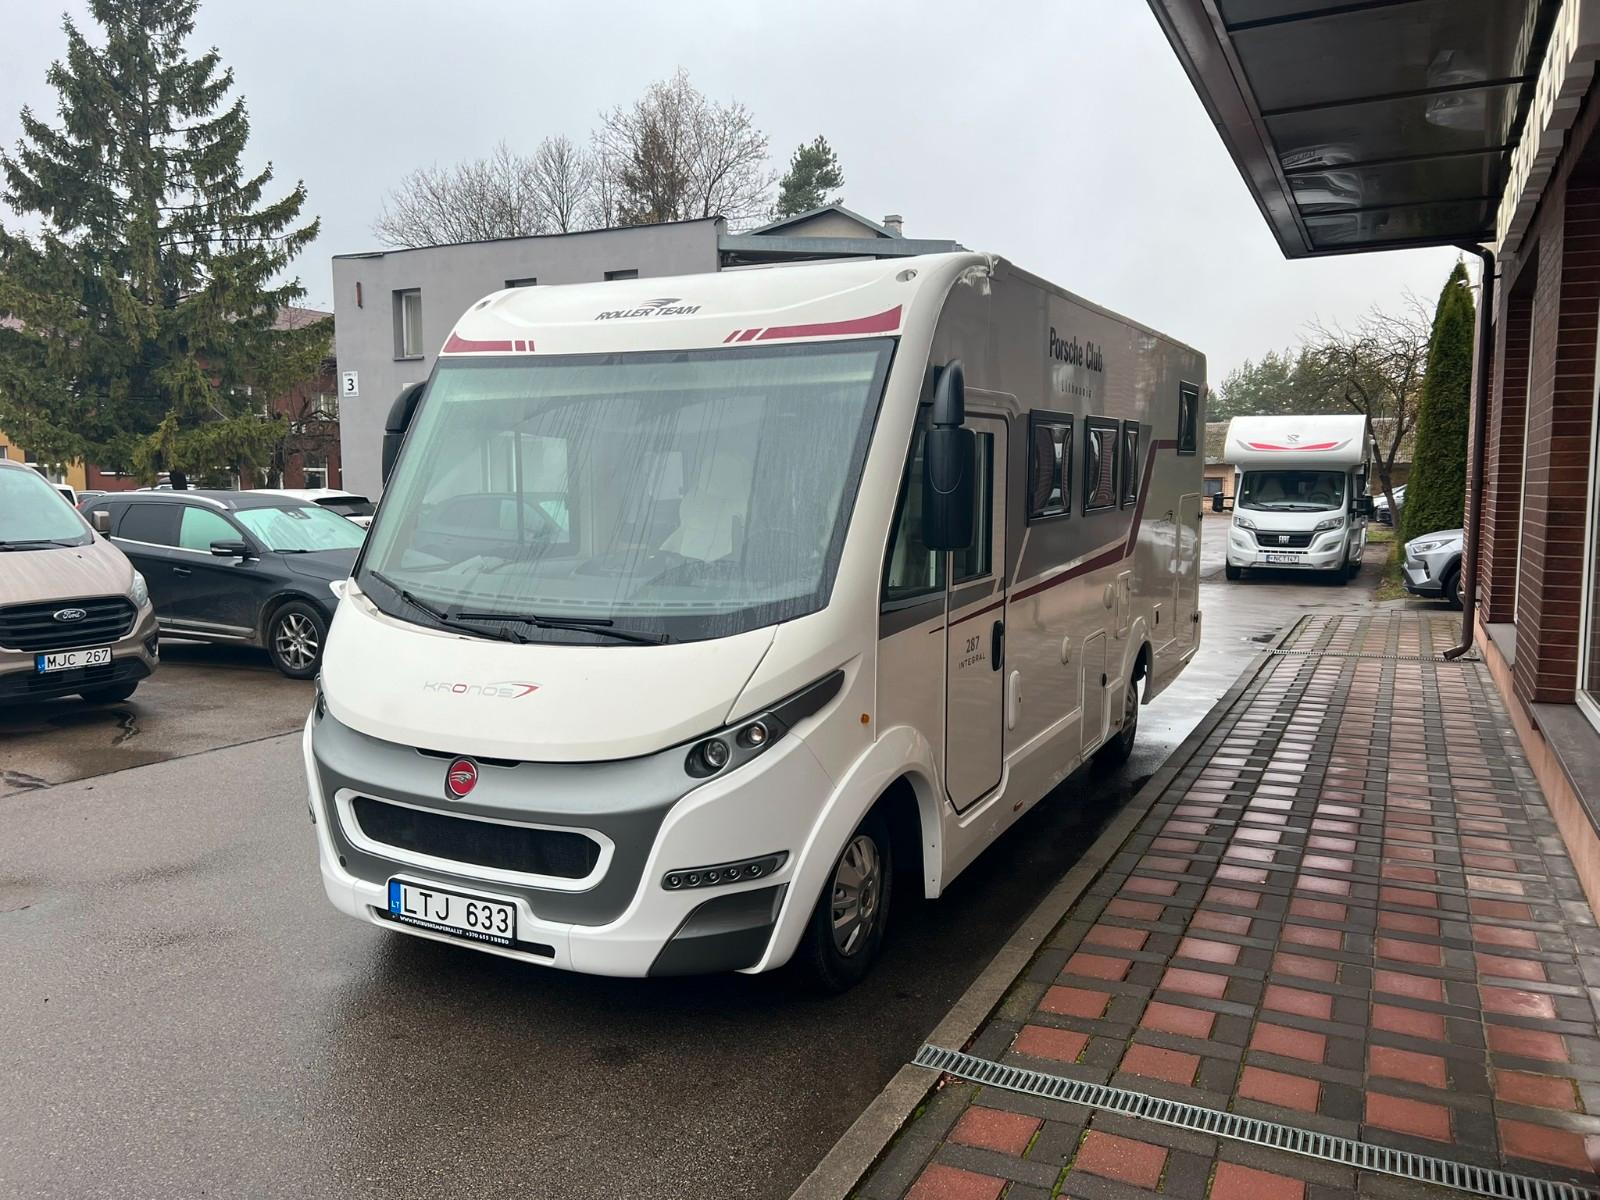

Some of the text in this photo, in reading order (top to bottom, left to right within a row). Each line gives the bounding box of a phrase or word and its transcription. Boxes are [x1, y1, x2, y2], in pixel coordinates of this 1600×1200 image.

[594, 305, 702, 321] ROLLER TEAM
[1049, 327, 1103, 373] Porsche Club
[347, 378, 355, 391] 3
[1278, 535, 1290, 544] FIAT
[62, 610, 81, 619] Ford
[966, 635, 980, 653] 287
[47, 649, 108, 668] MJC 267
[958, 652, 986, 670] INTEGRAL
[391, 900, 400, 909] LT
[403, 887, 509, 933] LTJ 633
